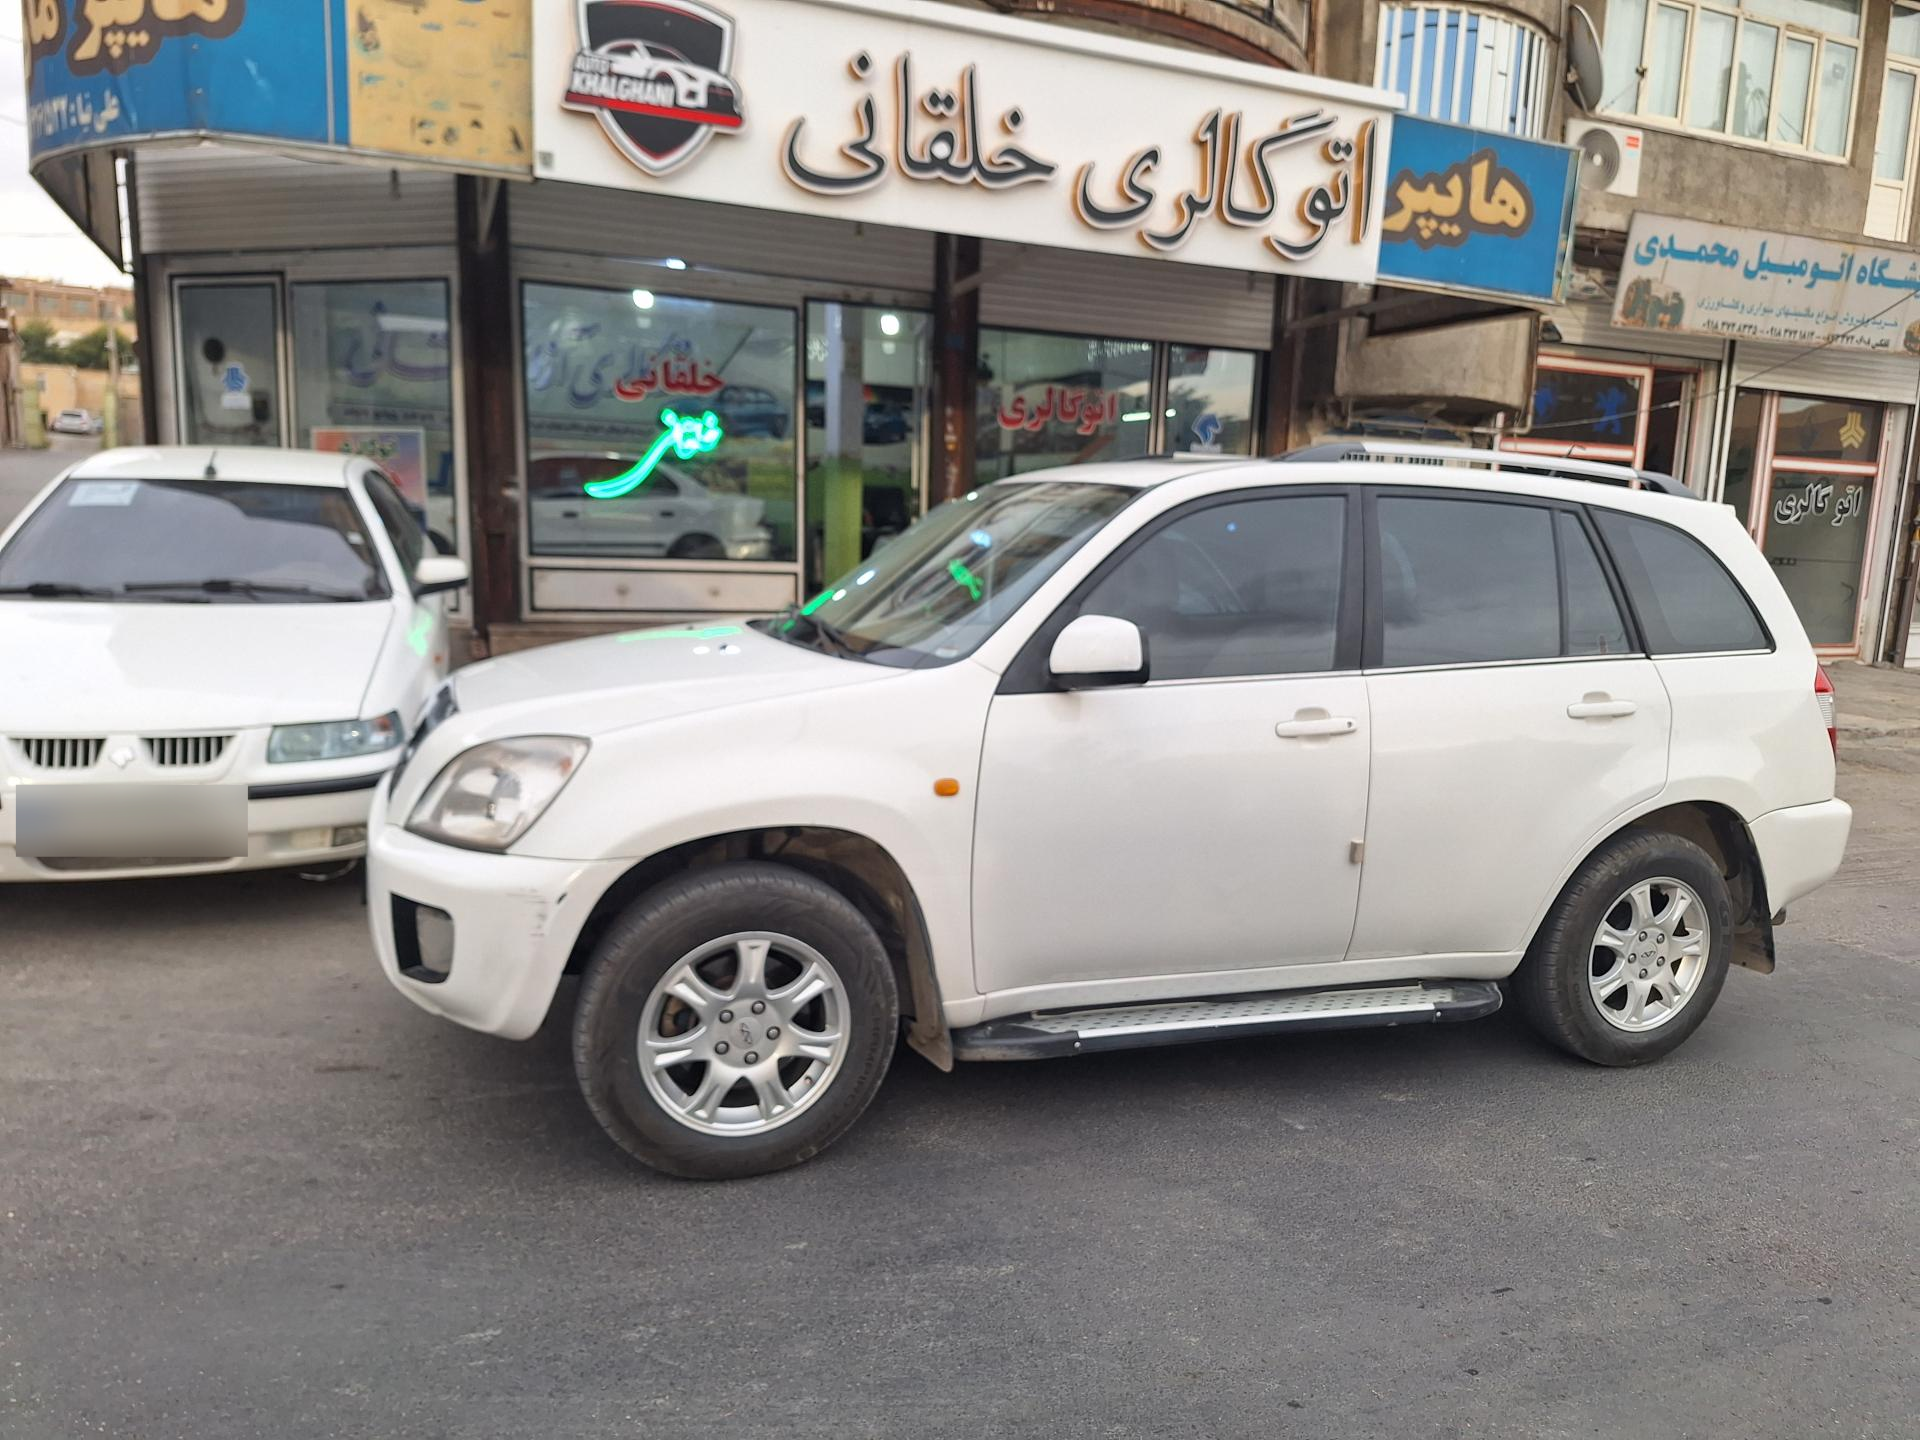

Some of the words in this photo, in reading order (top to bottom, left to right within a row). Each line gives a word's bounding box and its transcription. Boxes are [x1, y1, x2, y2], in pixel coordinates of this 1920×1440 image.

[571, 71, 675, 107] KHALGHANI
[784, 50, 1058, 195] خلقانی
[1384, 158, 1527, 238] هایپر
[1633, 234, 1740, 270] محمدی
[1743, 240, 1854, 288] اتومبیل
[1855, 255, 1920, 298] شگاه
[615, 355, 725, 402] خلقانی
